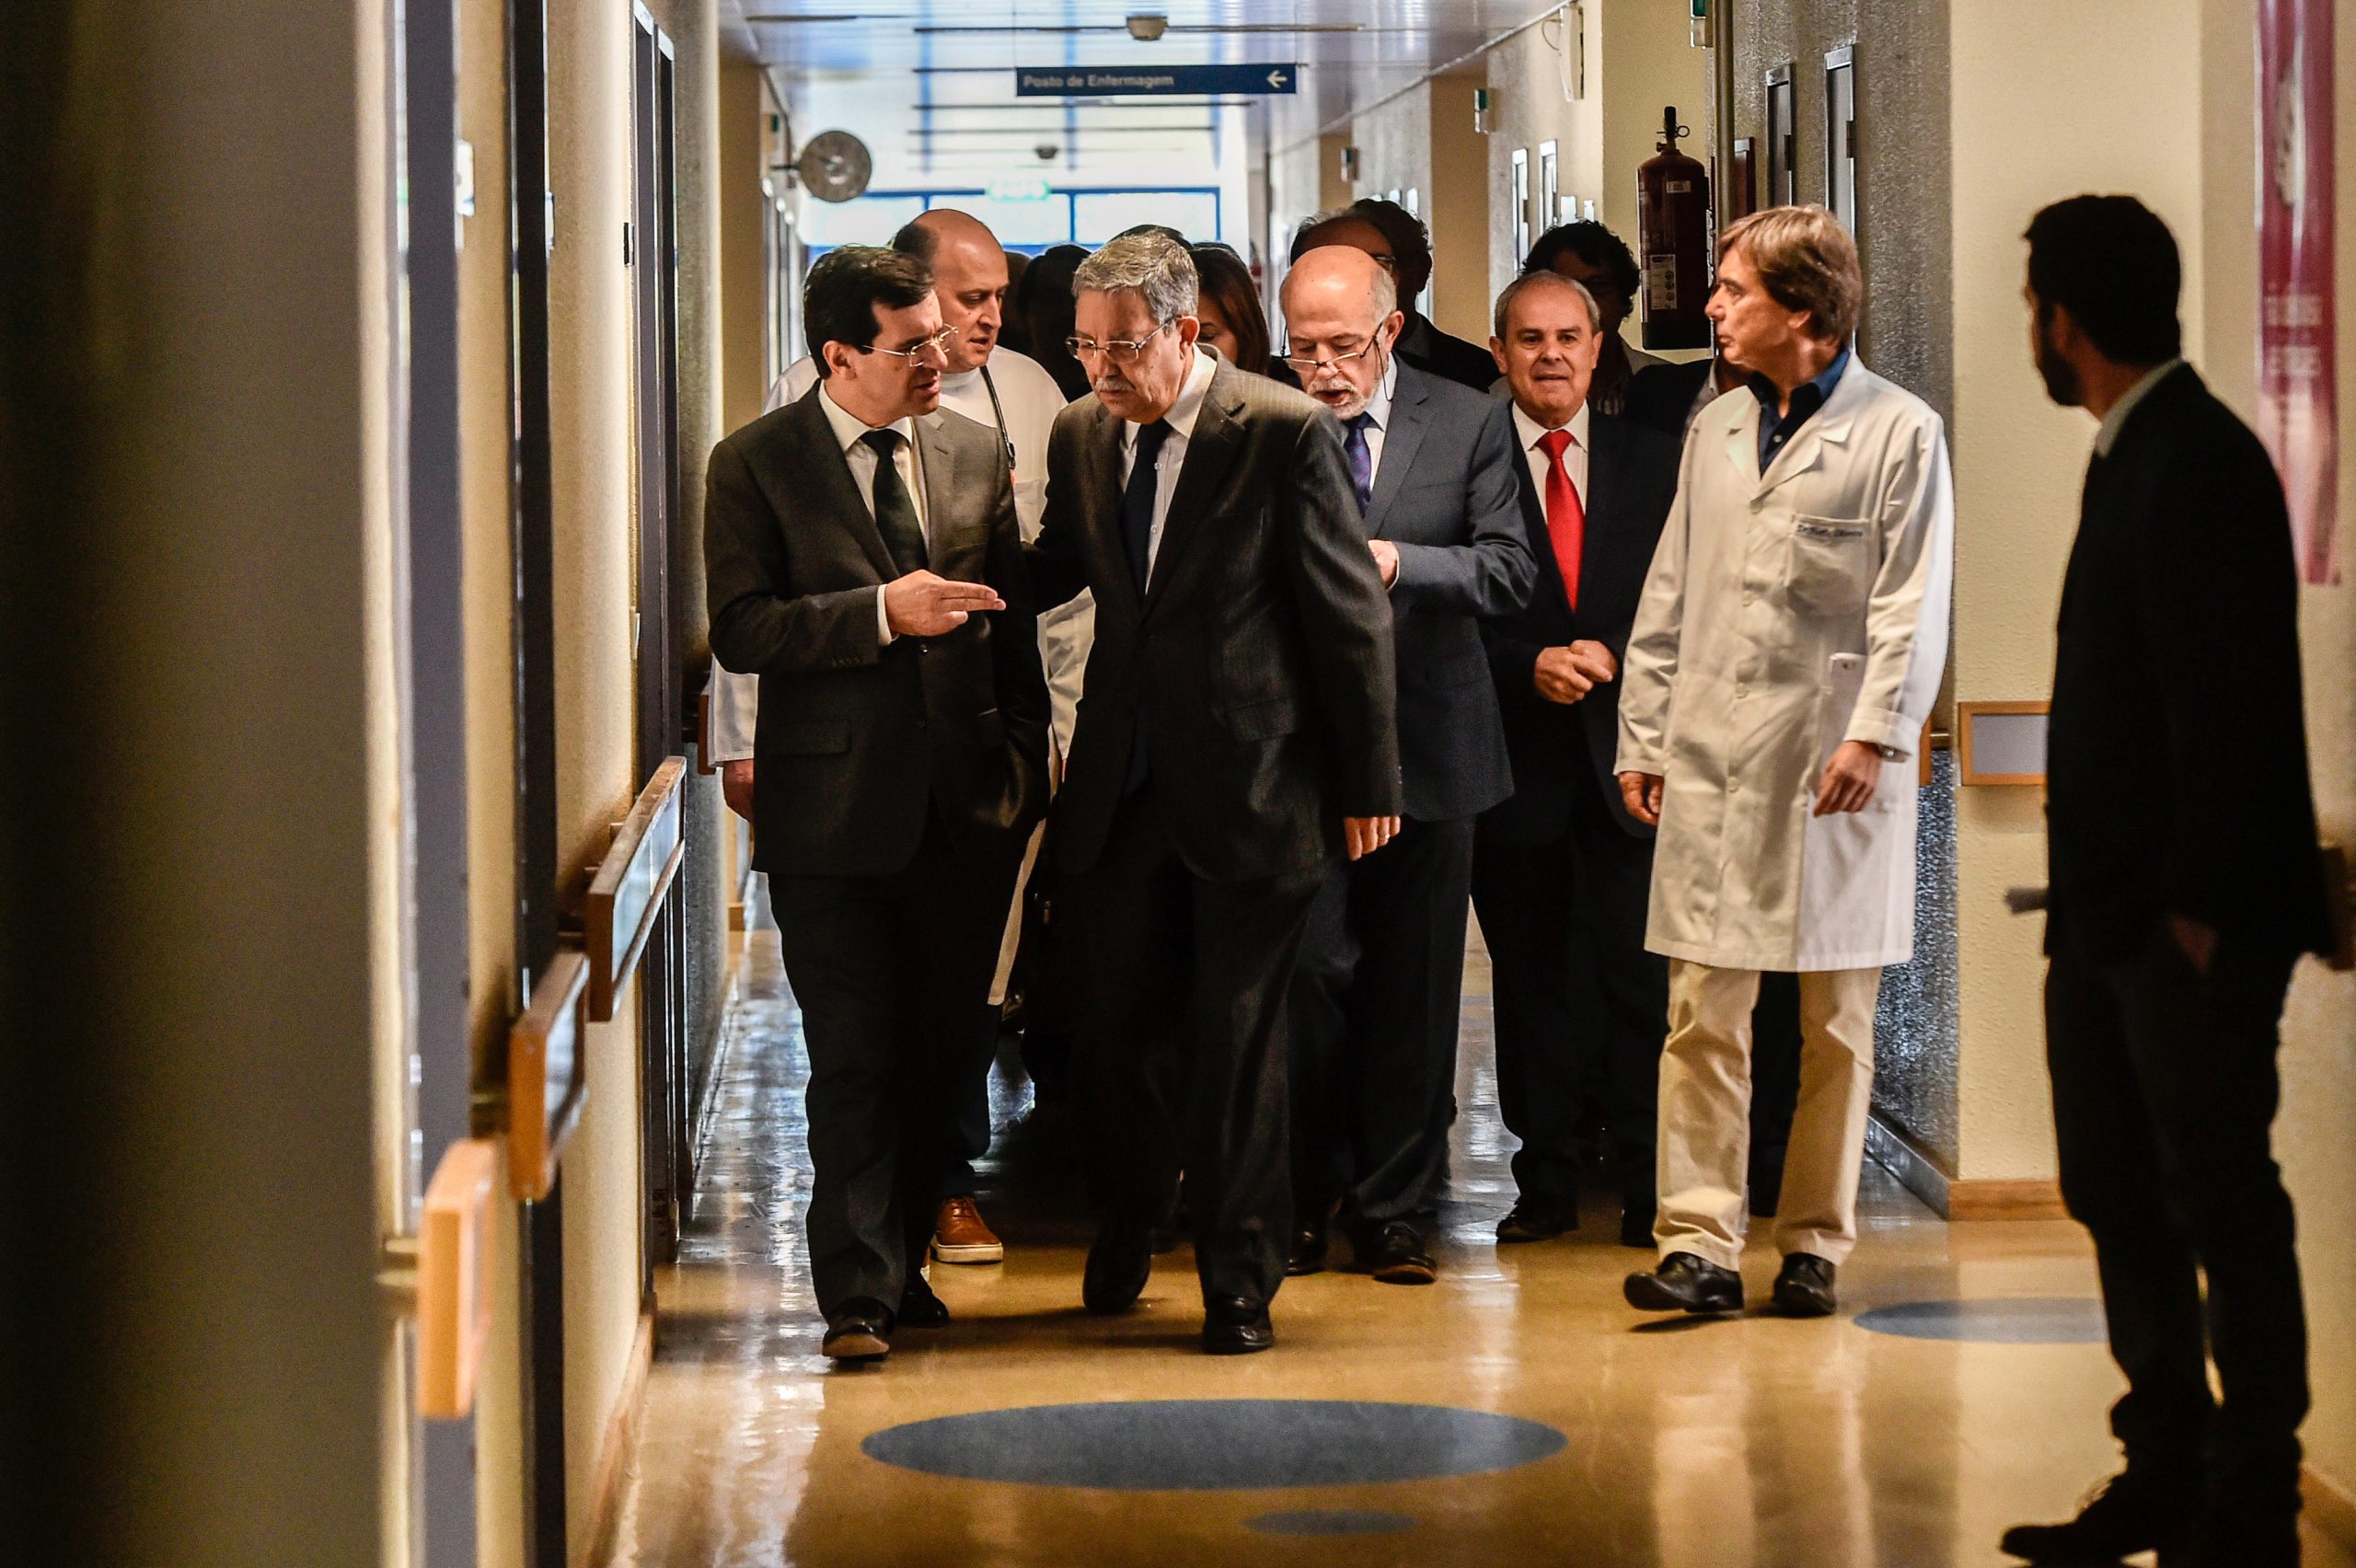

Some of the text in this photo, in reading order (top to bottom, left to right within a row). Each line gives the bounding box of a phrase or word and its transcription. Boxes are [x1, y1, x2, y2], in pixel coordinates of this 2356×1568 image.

[1022, 74, 1174, 89] Posto de Enfermagem
